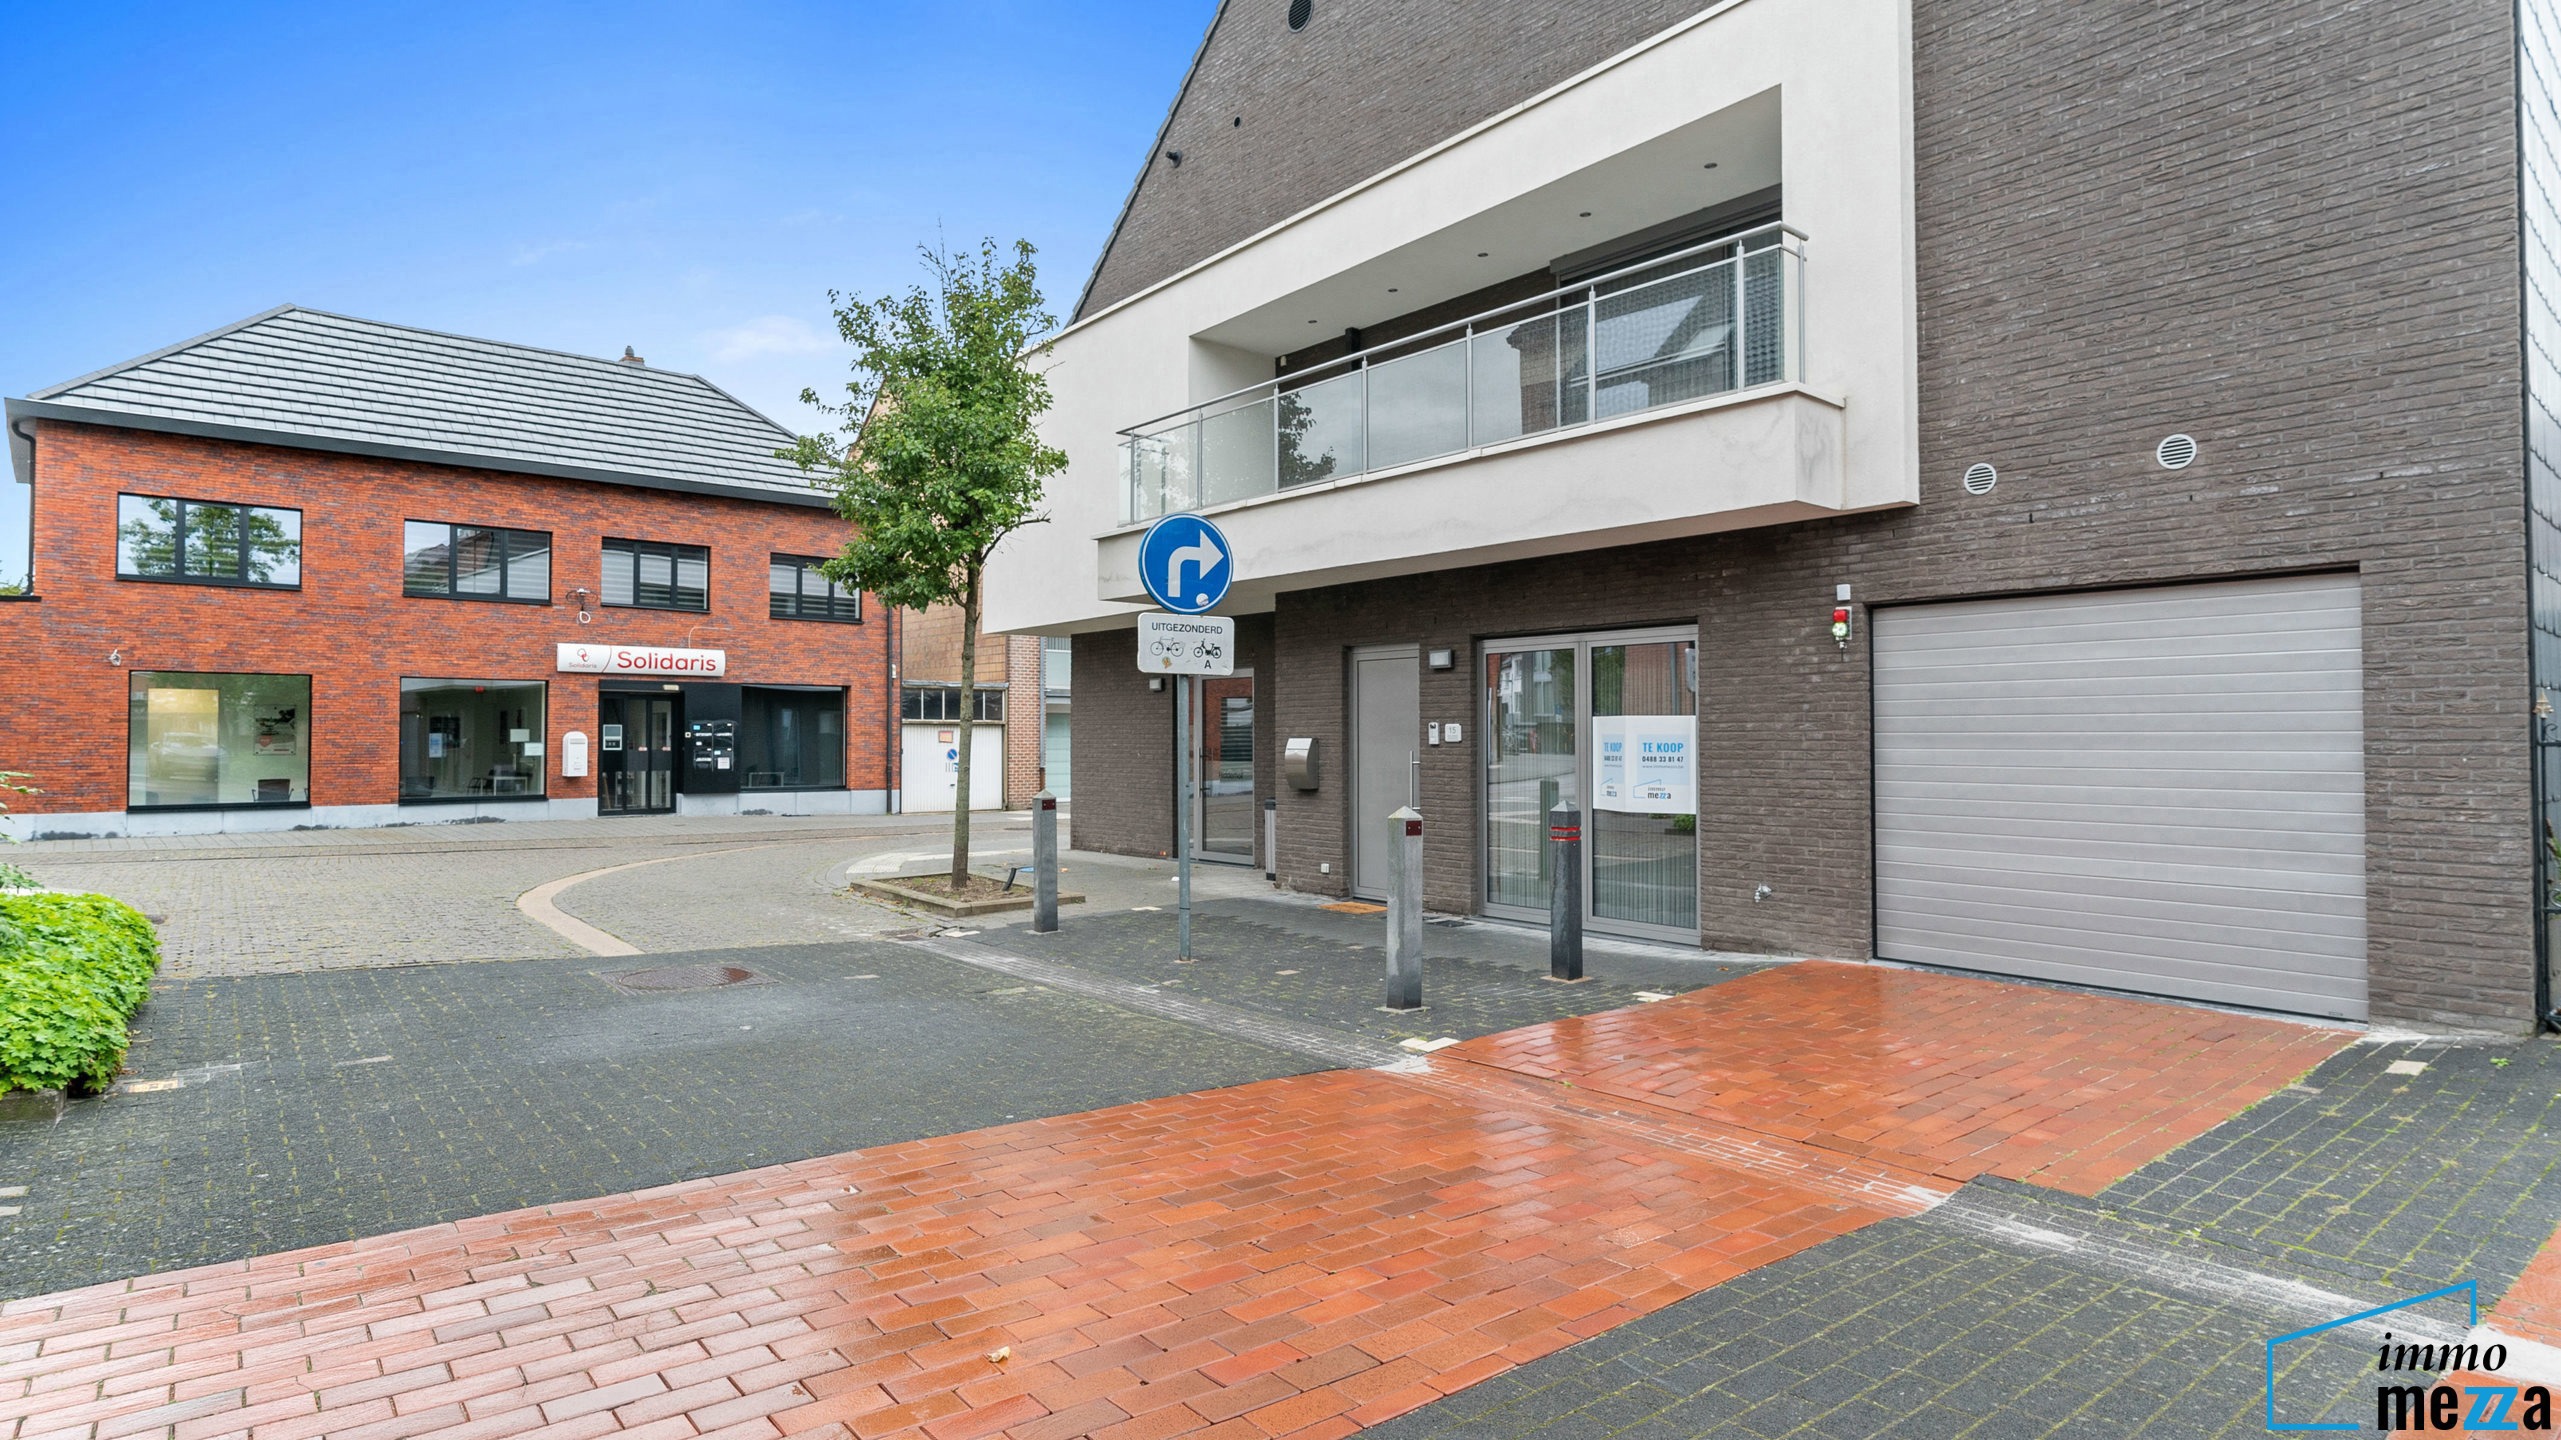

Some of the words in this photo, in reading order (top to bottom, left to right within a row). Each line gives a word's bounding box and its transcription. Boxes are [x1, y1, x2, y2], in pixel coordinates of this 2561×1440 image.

[1151, 622, 1223, 634] UITGEZONDERD
[617, 651, 717, 672] Solidaris
[1204, 659, 1212, 669] A
[1448, 726, 1457, 735] 15
[1642, 742, 1653, 753] TE
[1656, 742, 1684, 753] KOOP
[1677, 755, 1684, 763] 47
